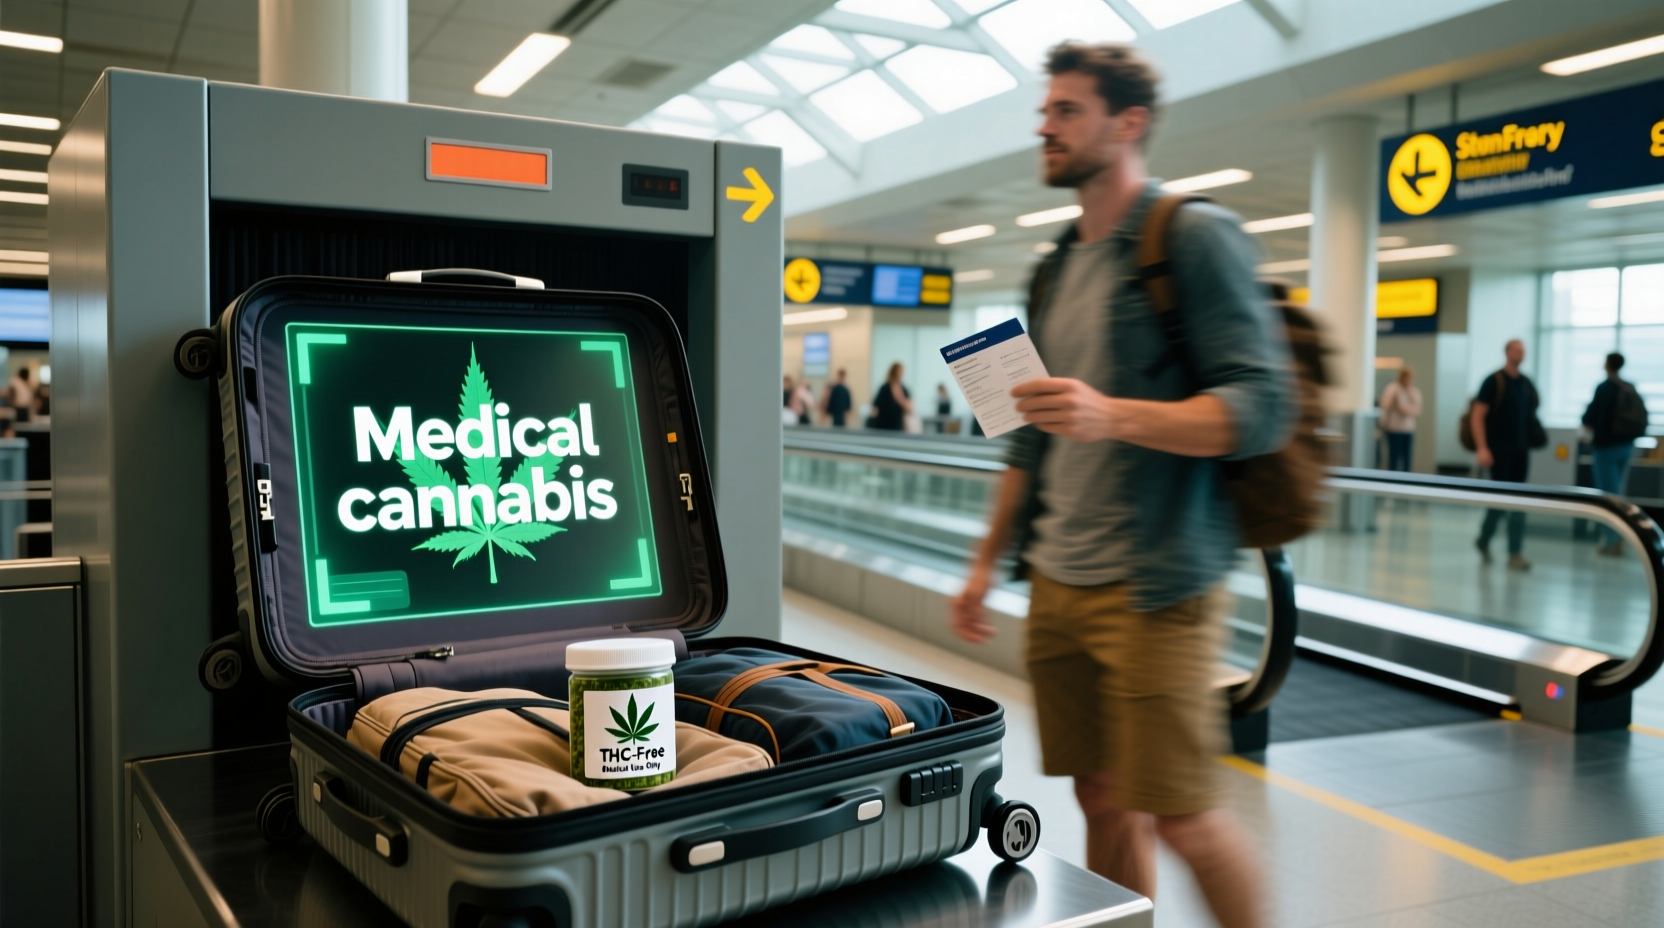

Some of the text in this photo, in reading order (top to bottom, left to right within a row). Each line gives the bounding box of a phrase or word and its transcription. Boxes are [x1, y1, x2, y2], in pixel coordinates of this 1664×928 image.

[352, 402, 600, 462] Medical
[337, 464, 618, 532] cannabis
[599, 746, 665, 763] THC-Free
